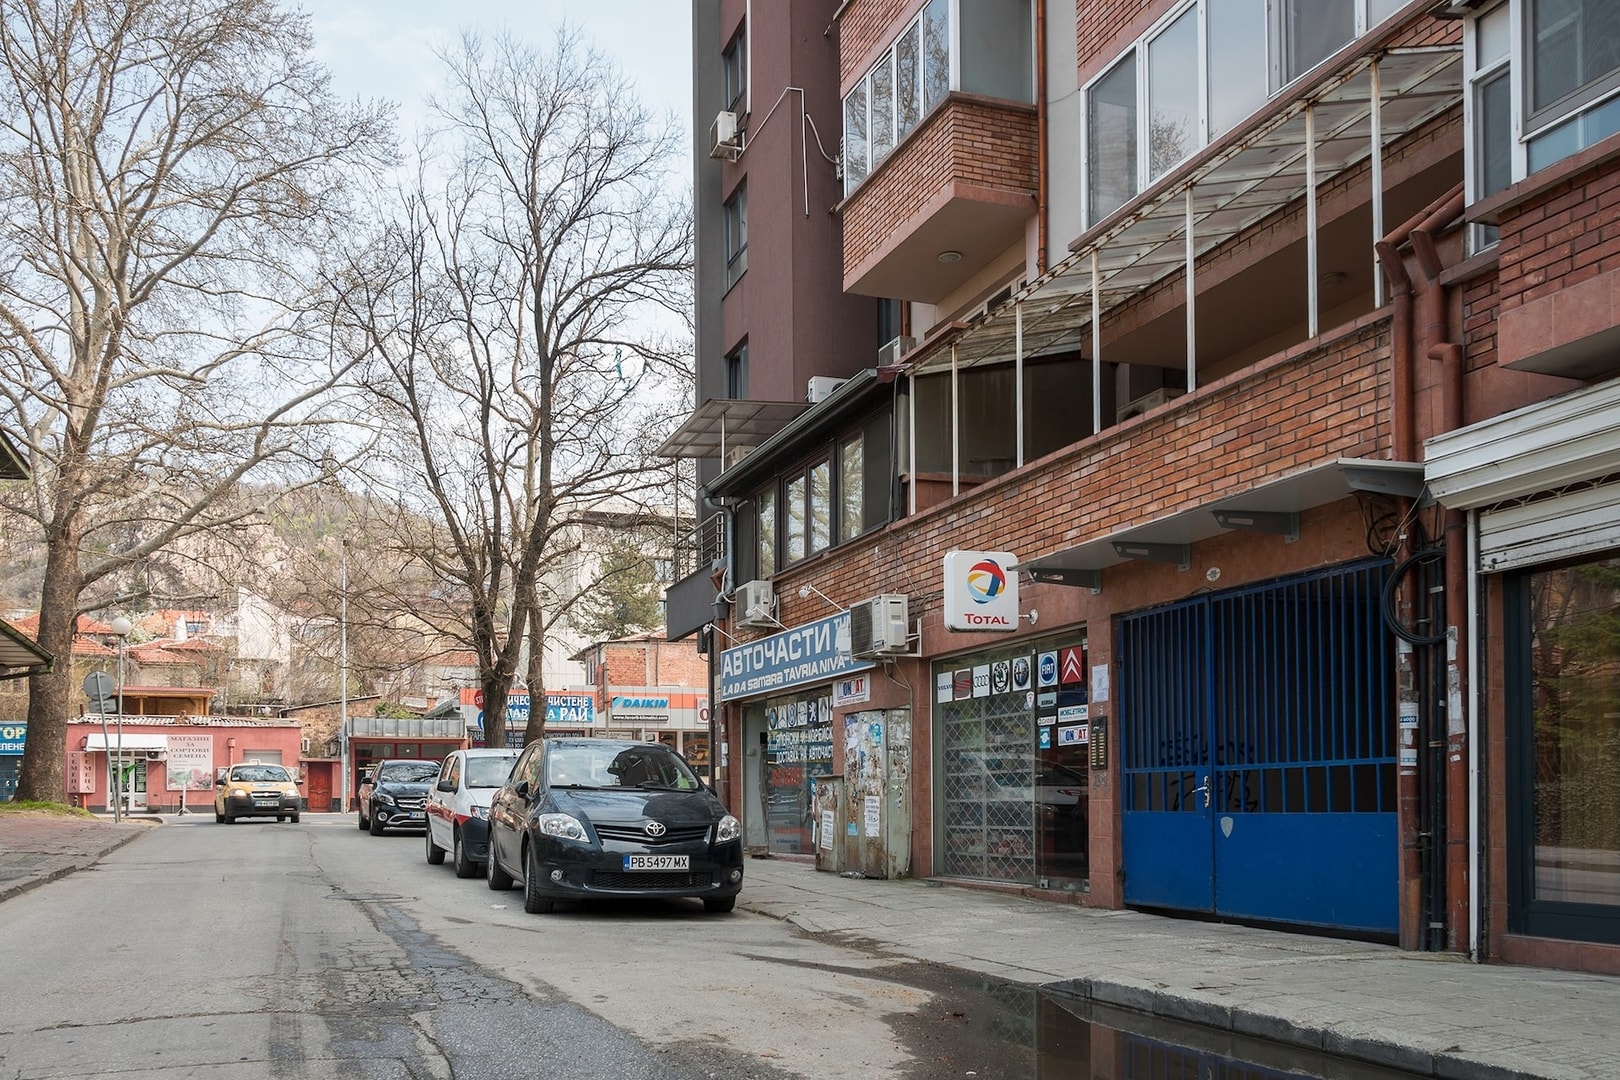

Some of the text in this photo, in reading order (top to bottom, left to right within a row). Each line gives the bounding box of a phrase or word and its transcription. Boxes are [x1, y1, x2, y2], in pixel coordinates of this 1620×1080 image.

[964, 613, 1010, 625] TOTAL
[722, 622, 831, 679] АВТОЧАСТИ
[1041, 662, 1055, 675] FIAT
[722, 680, 747, 697] LADA
[783, 660, 819, 682] TAVRIA
[548, 696, 589, 707] ЧИСТЕНЕ
[622, 698, 668, 708] DAIKIN
[560, 707, 588, 721] РАЙ
[0, 726, 26, 740] ОР
[808, 744, 834, 760] АВТОЧАСТ
